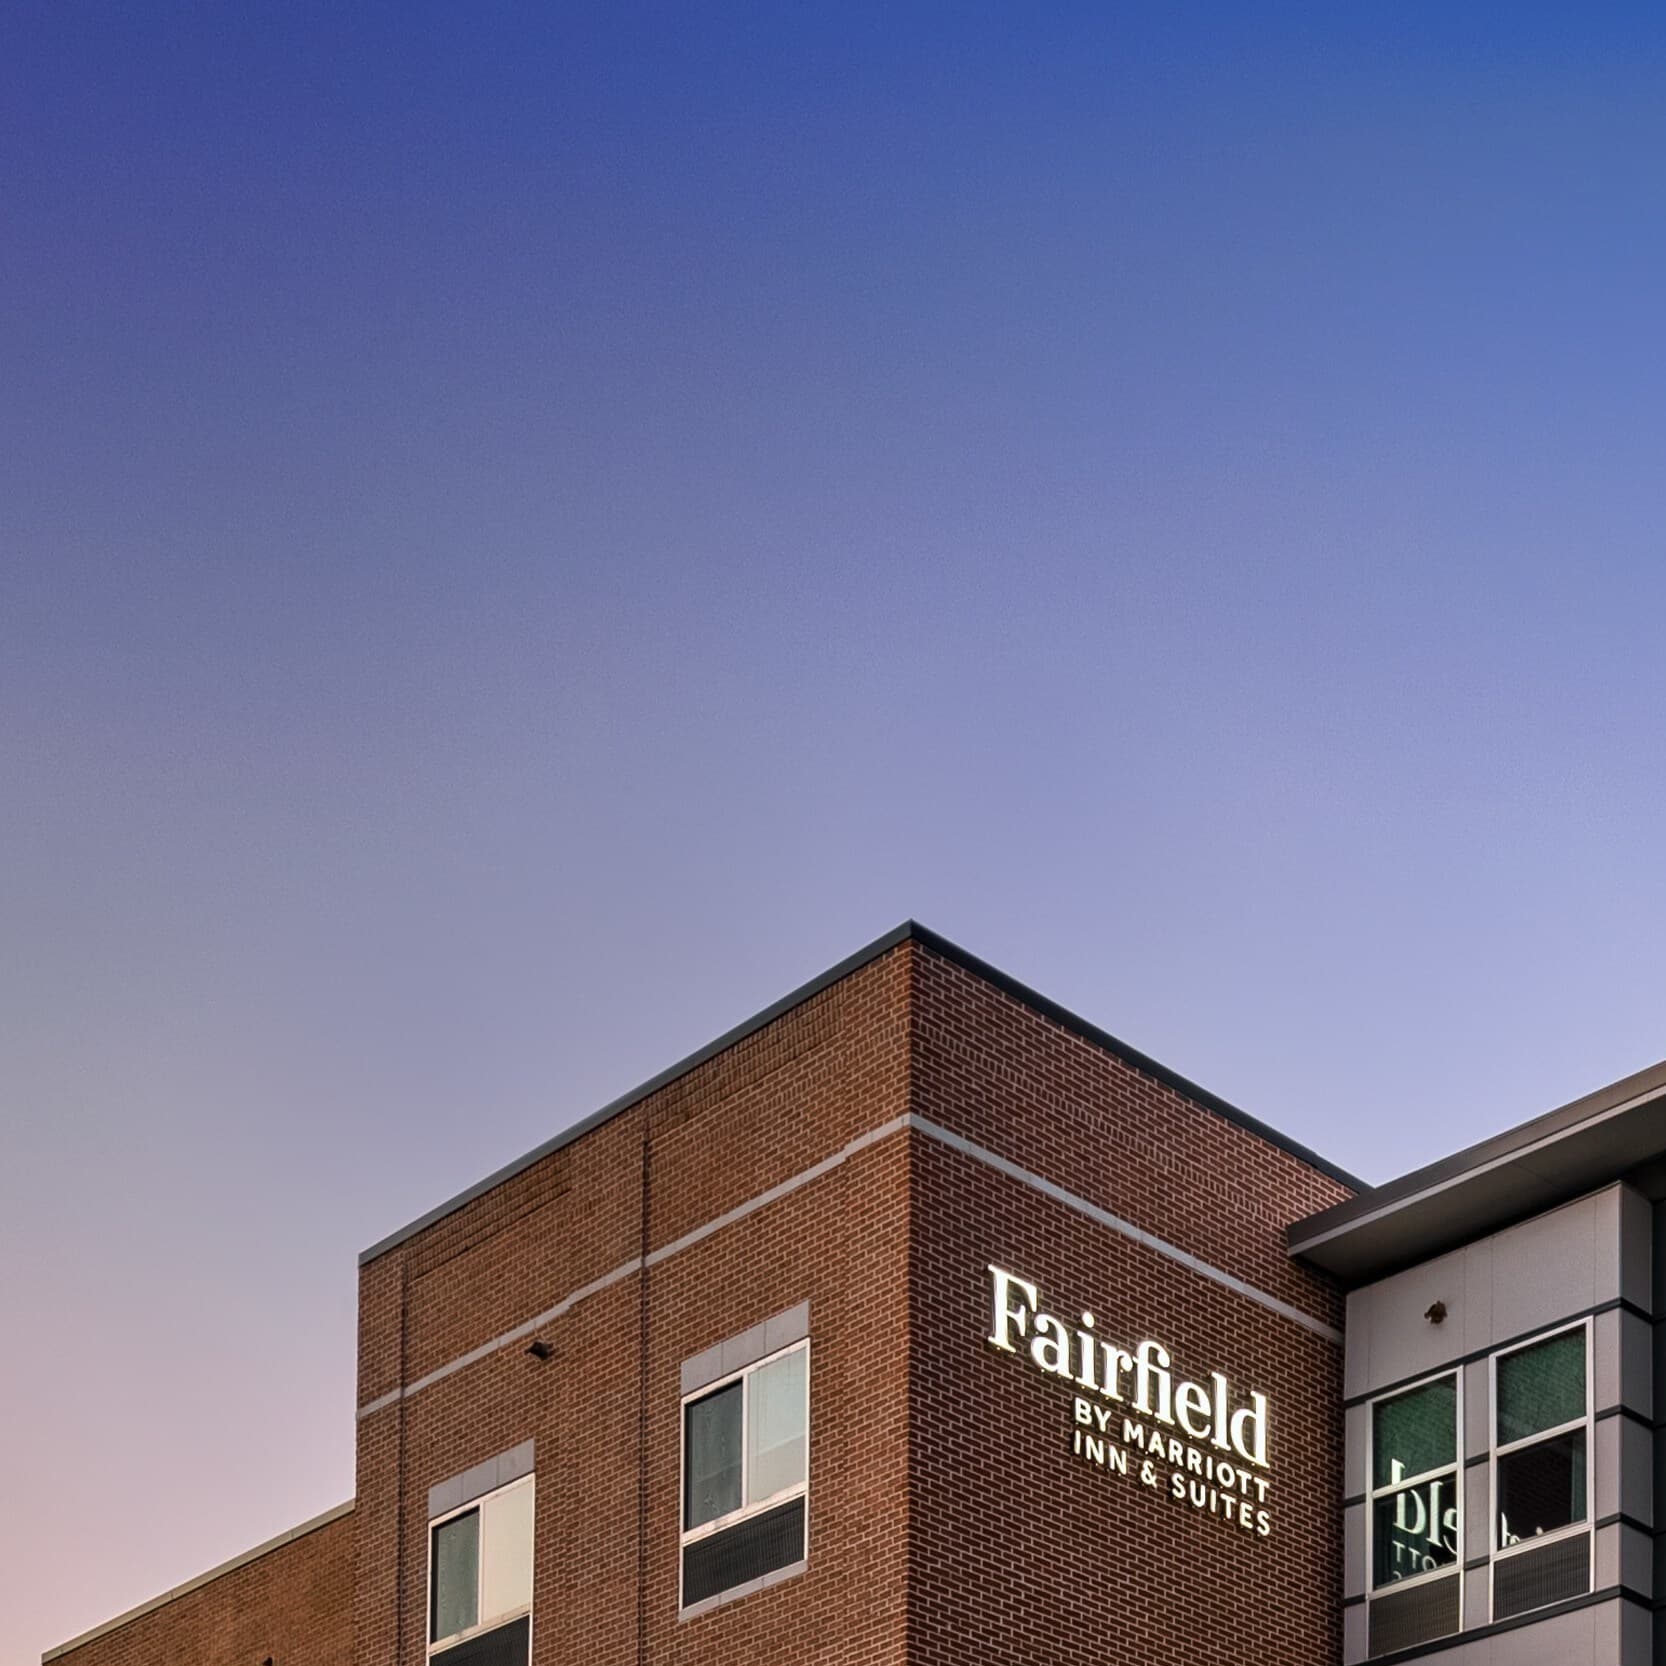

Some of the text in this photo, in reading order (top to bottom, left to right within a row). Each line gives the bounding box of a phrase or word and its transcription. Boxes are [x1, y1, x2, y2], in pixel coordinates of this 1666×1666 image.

[988, 1263, 1271, 1468] Fairfield
[1073, 1429, 1271, 1537] INN & SUITES
[1074, 1396, 1271, 1503] BY MARRIOTT
